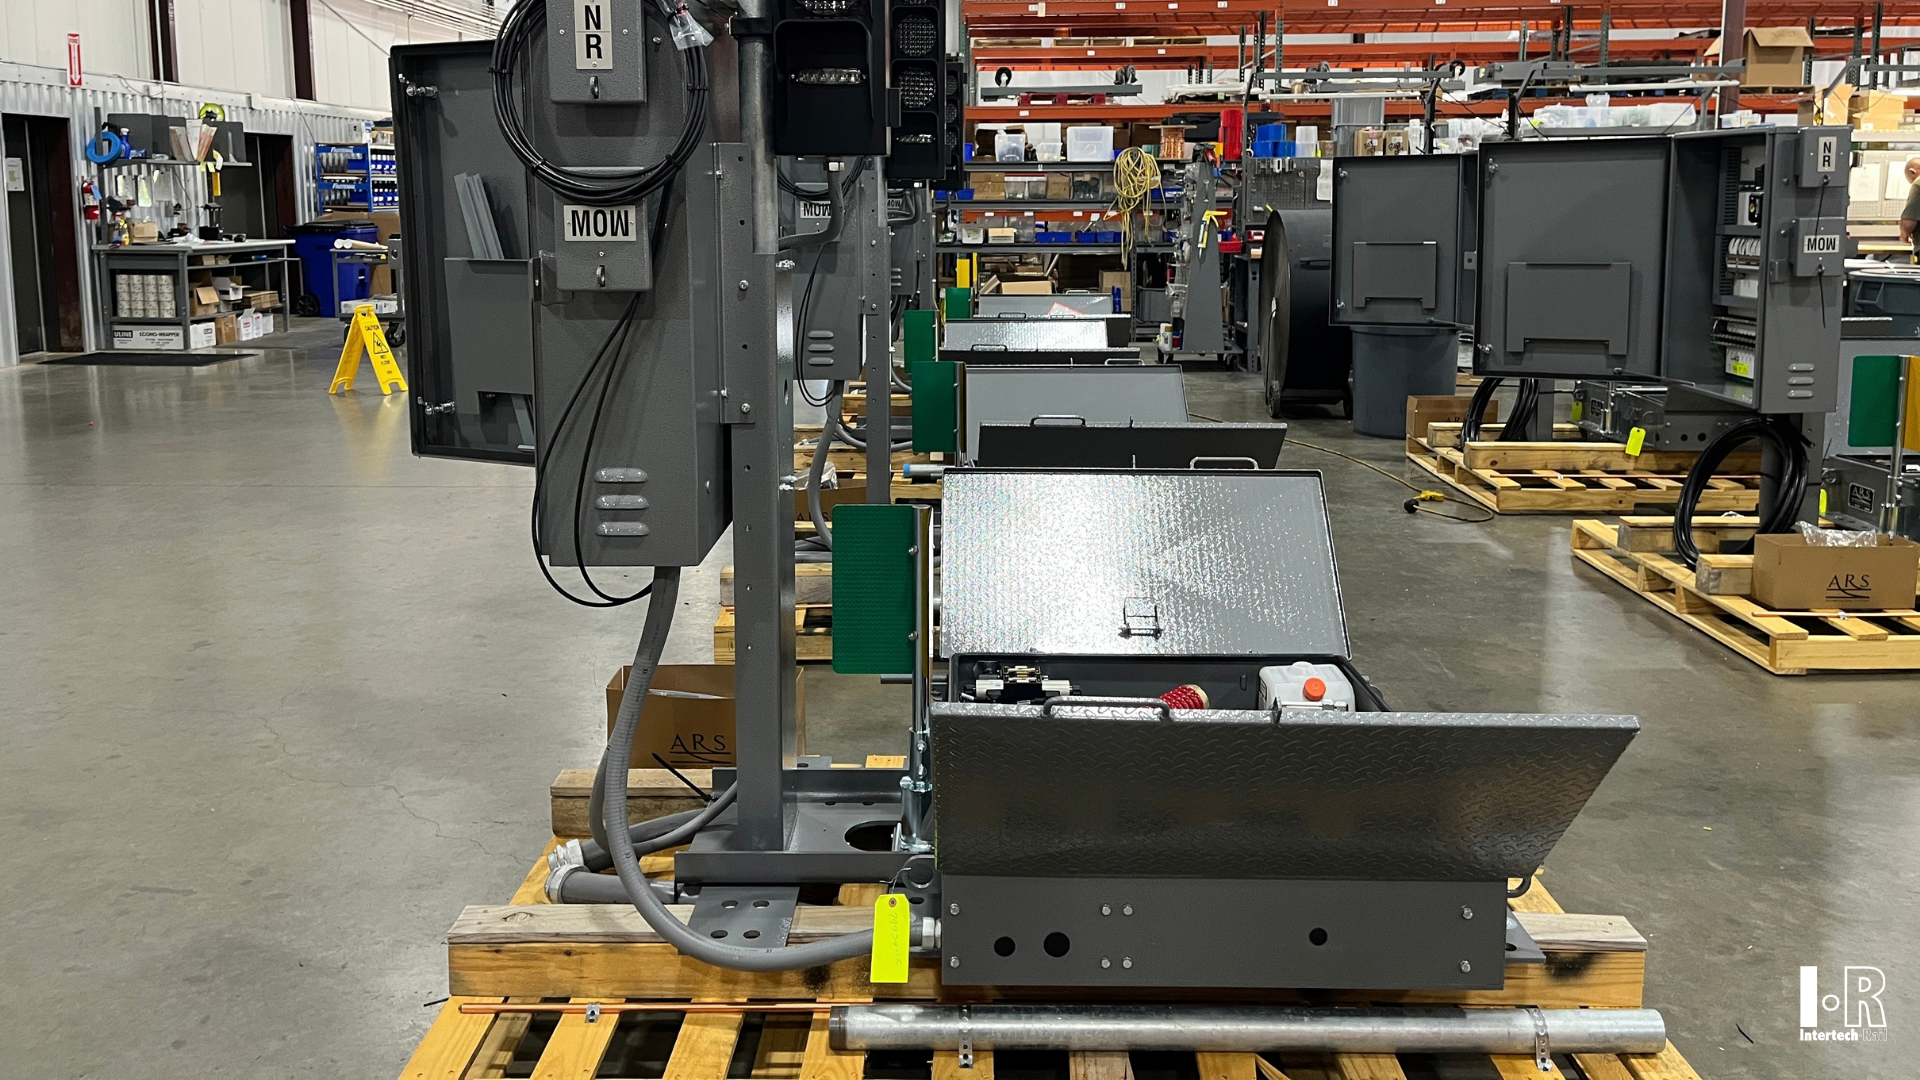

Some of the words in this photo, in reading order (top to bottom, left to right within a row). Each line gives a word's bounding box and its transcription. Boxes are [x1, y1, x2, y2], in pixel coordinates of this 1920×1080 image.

[584, 4, 602, 31] N
[585, 33, 603, 59] R
[1823, 141, 1832, 154] N
[1822, 154, 1831, 167] R
[571, 208, 630, 237] MOW
[1807, 237, 1836, 251] MOW
[1828, 574, 1870, 590] ARS
[670, 733, 728, 753] ARS
